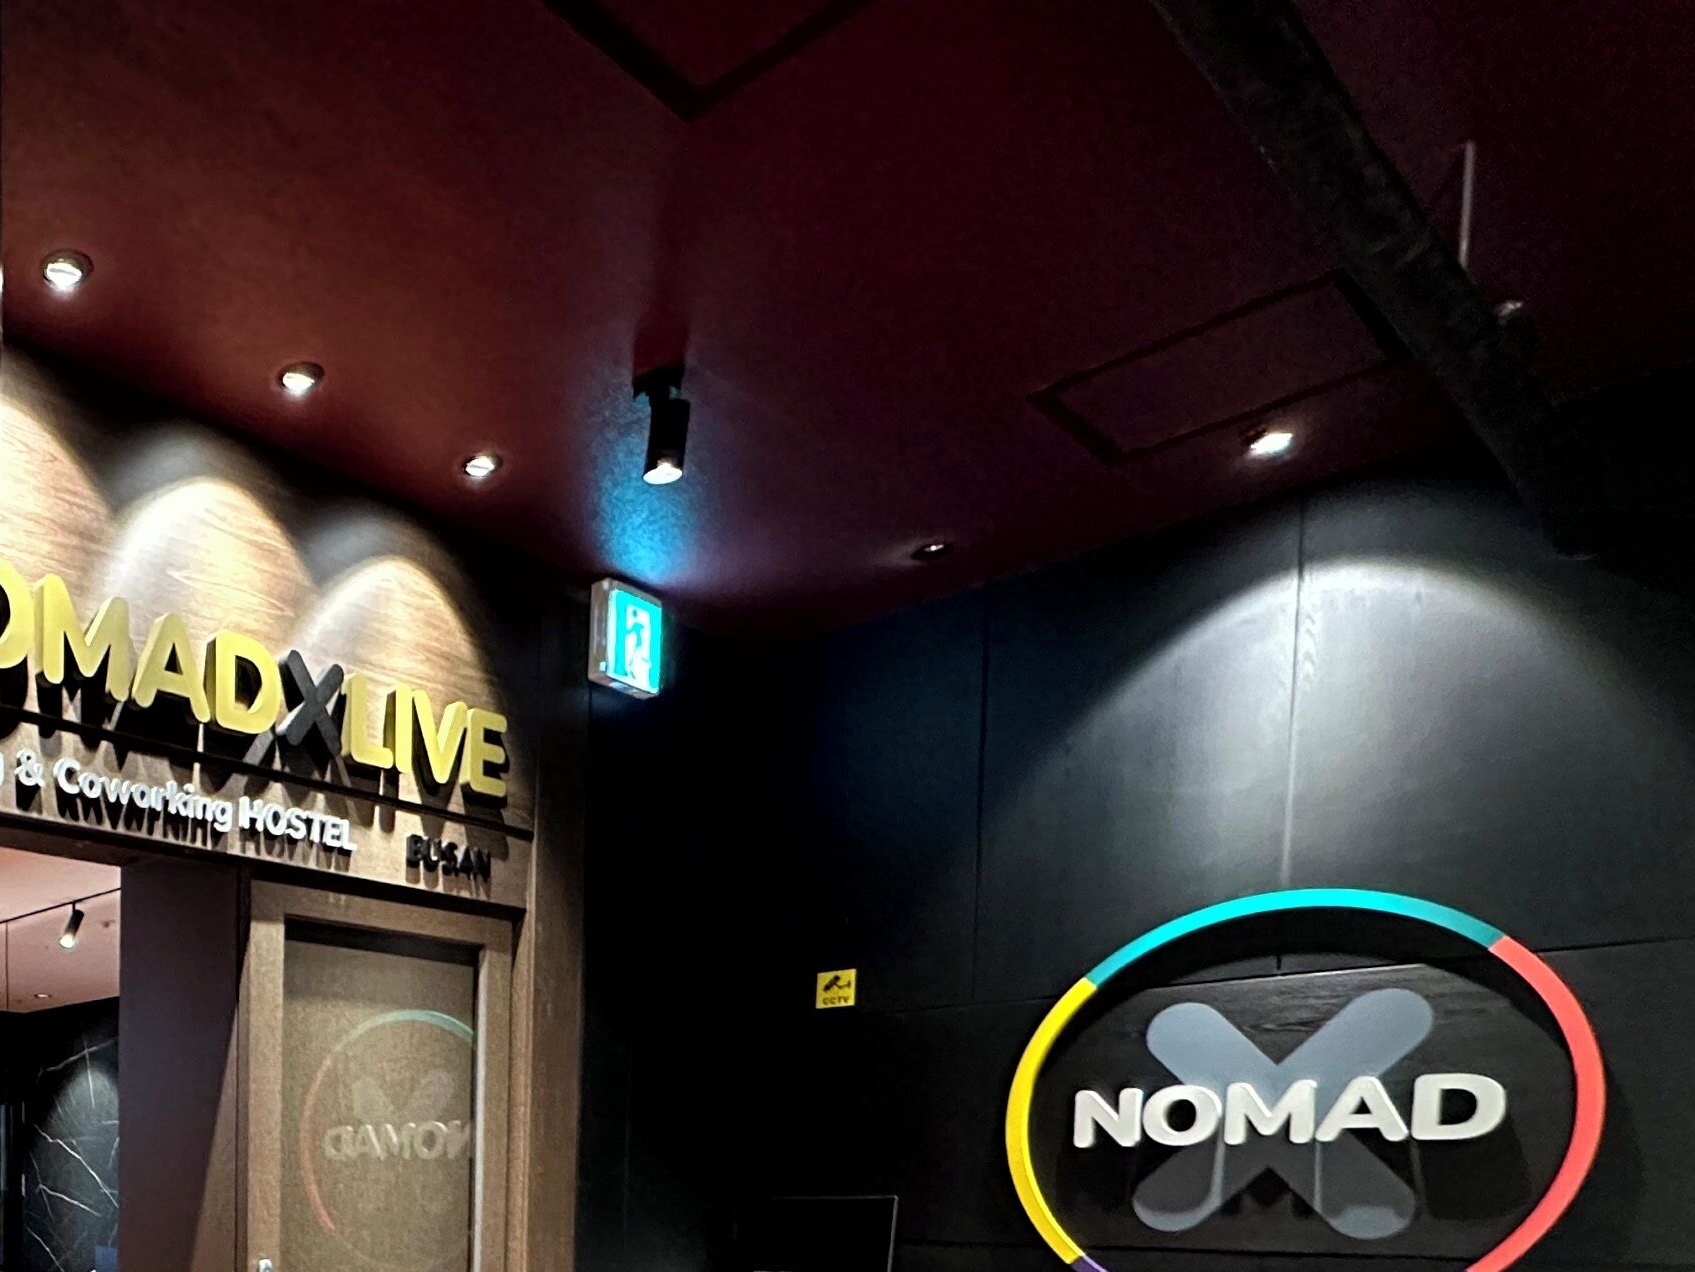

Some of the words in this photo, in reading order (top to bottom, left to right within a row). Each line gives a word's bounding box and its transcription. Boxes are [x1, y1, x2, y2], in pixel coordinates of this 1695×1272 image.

[14, 749, 46, 787] &
[55, 757, 233, 832] Coworking
[238, 796, 357, 851] HOSTEL
[405, 833, 492, 883] BUSAN
[1073, 1072, 1507, 1149] NOMAD
